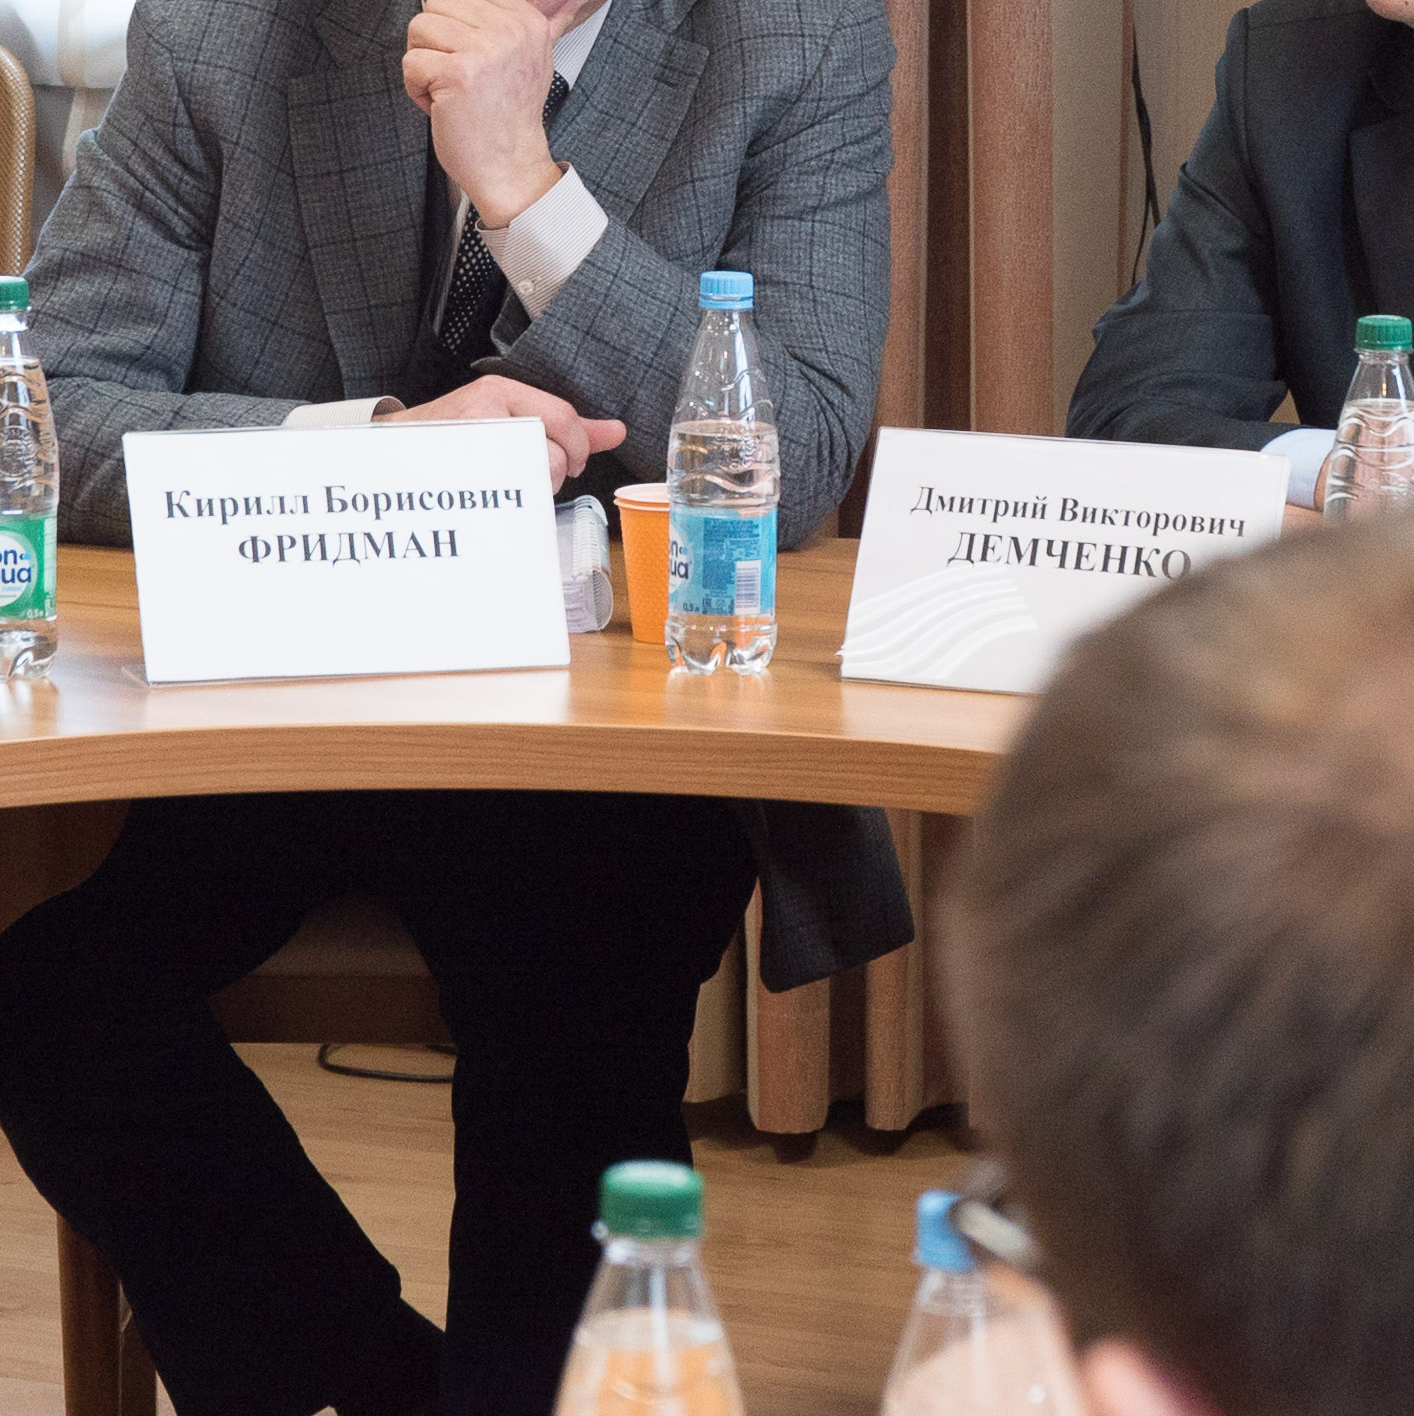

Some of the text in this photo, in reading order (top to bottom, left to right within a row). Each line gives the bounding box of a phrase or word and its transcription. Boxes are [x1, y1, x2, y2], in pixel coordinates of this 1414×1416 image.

[165, 485, 524, 525] Кирилл Борисович
[910, 486, 1245, 537] Дмитрий Викторович
[238, 529, 459, 568] ФРИДМАН
[947, 531, 1192, 580] ДЕМЧЕНКО
